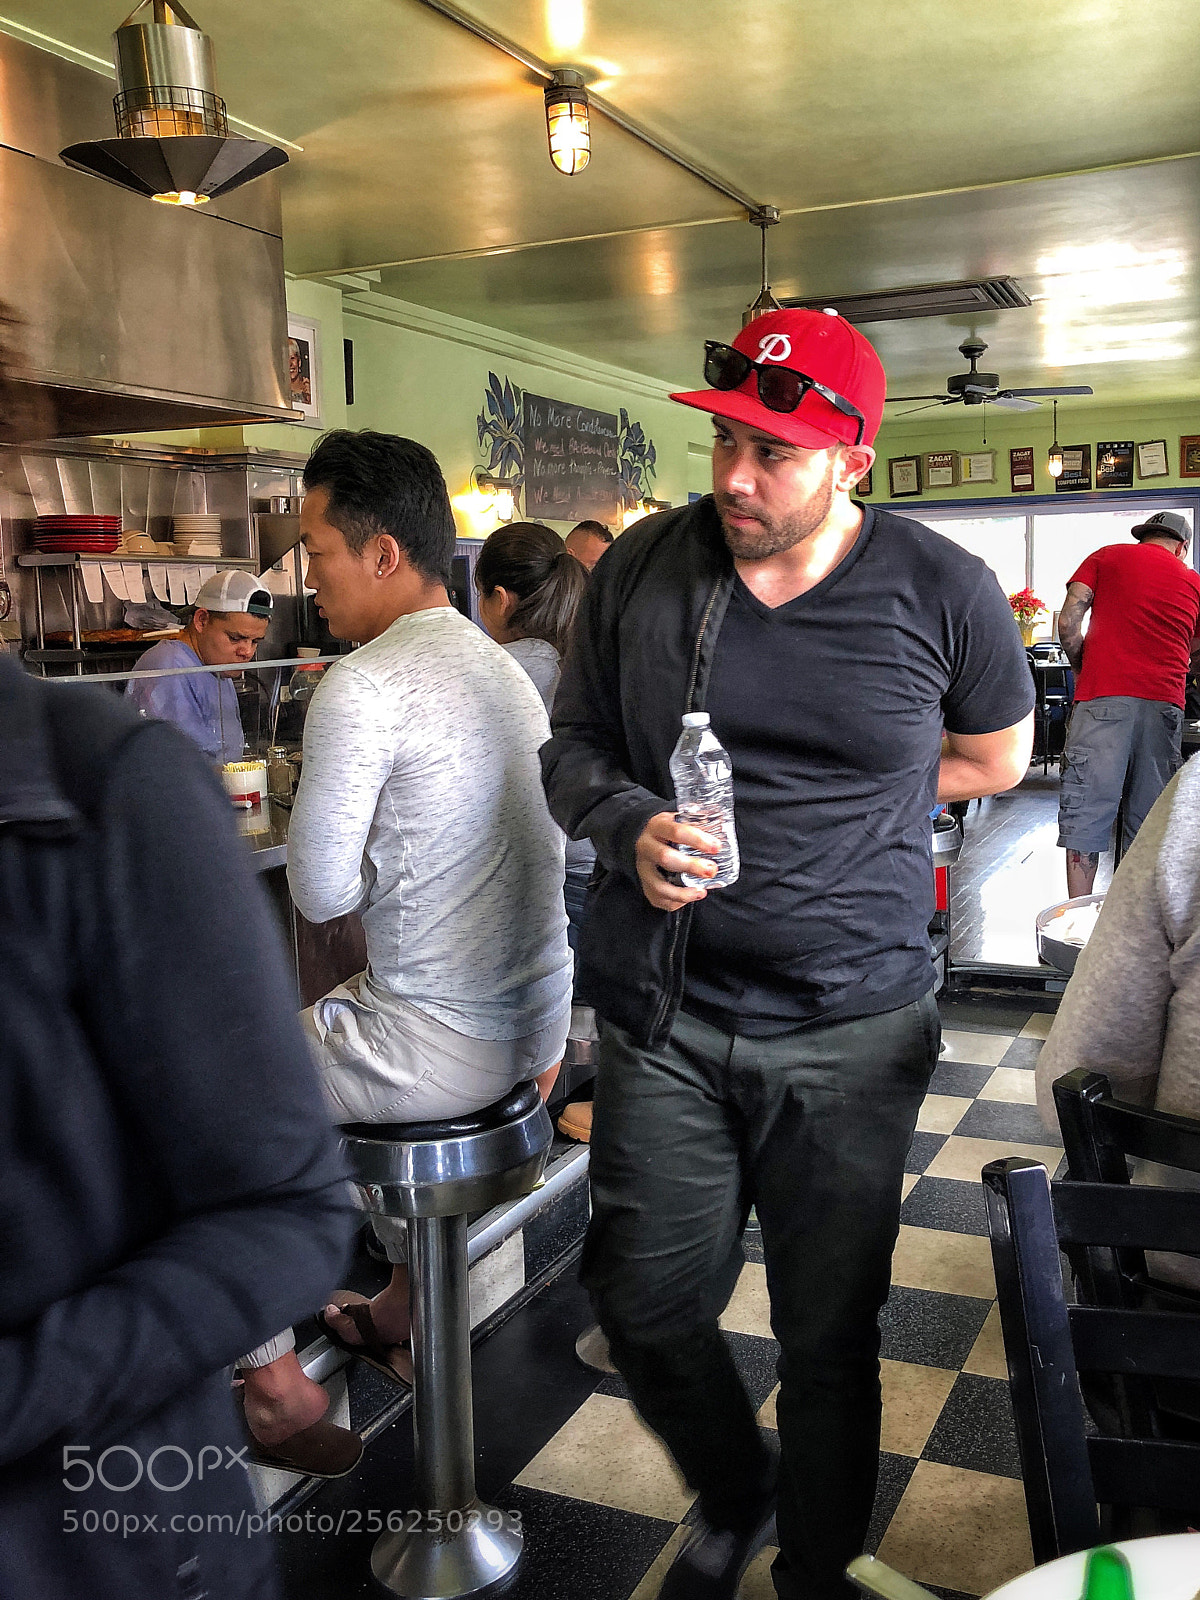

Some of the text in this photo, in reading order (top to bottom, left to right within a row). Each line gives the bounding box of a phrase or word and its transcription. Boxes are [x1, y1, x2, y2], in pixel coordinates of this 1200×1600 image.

[755, 333, 792, 364] P
[529, 404, 542, 427] No
[547, 405, 572, 429] More
[534, 437, 549, 454] We
[928, 454, 953, 462] ZAGAT
[533, 458, 545, 477] No
[547, 463, 566, 476] more
[1063, 471, 1082, 479] Best
[1100, 464, 1115, 473] Best
[533, 485, 549, 504] We
